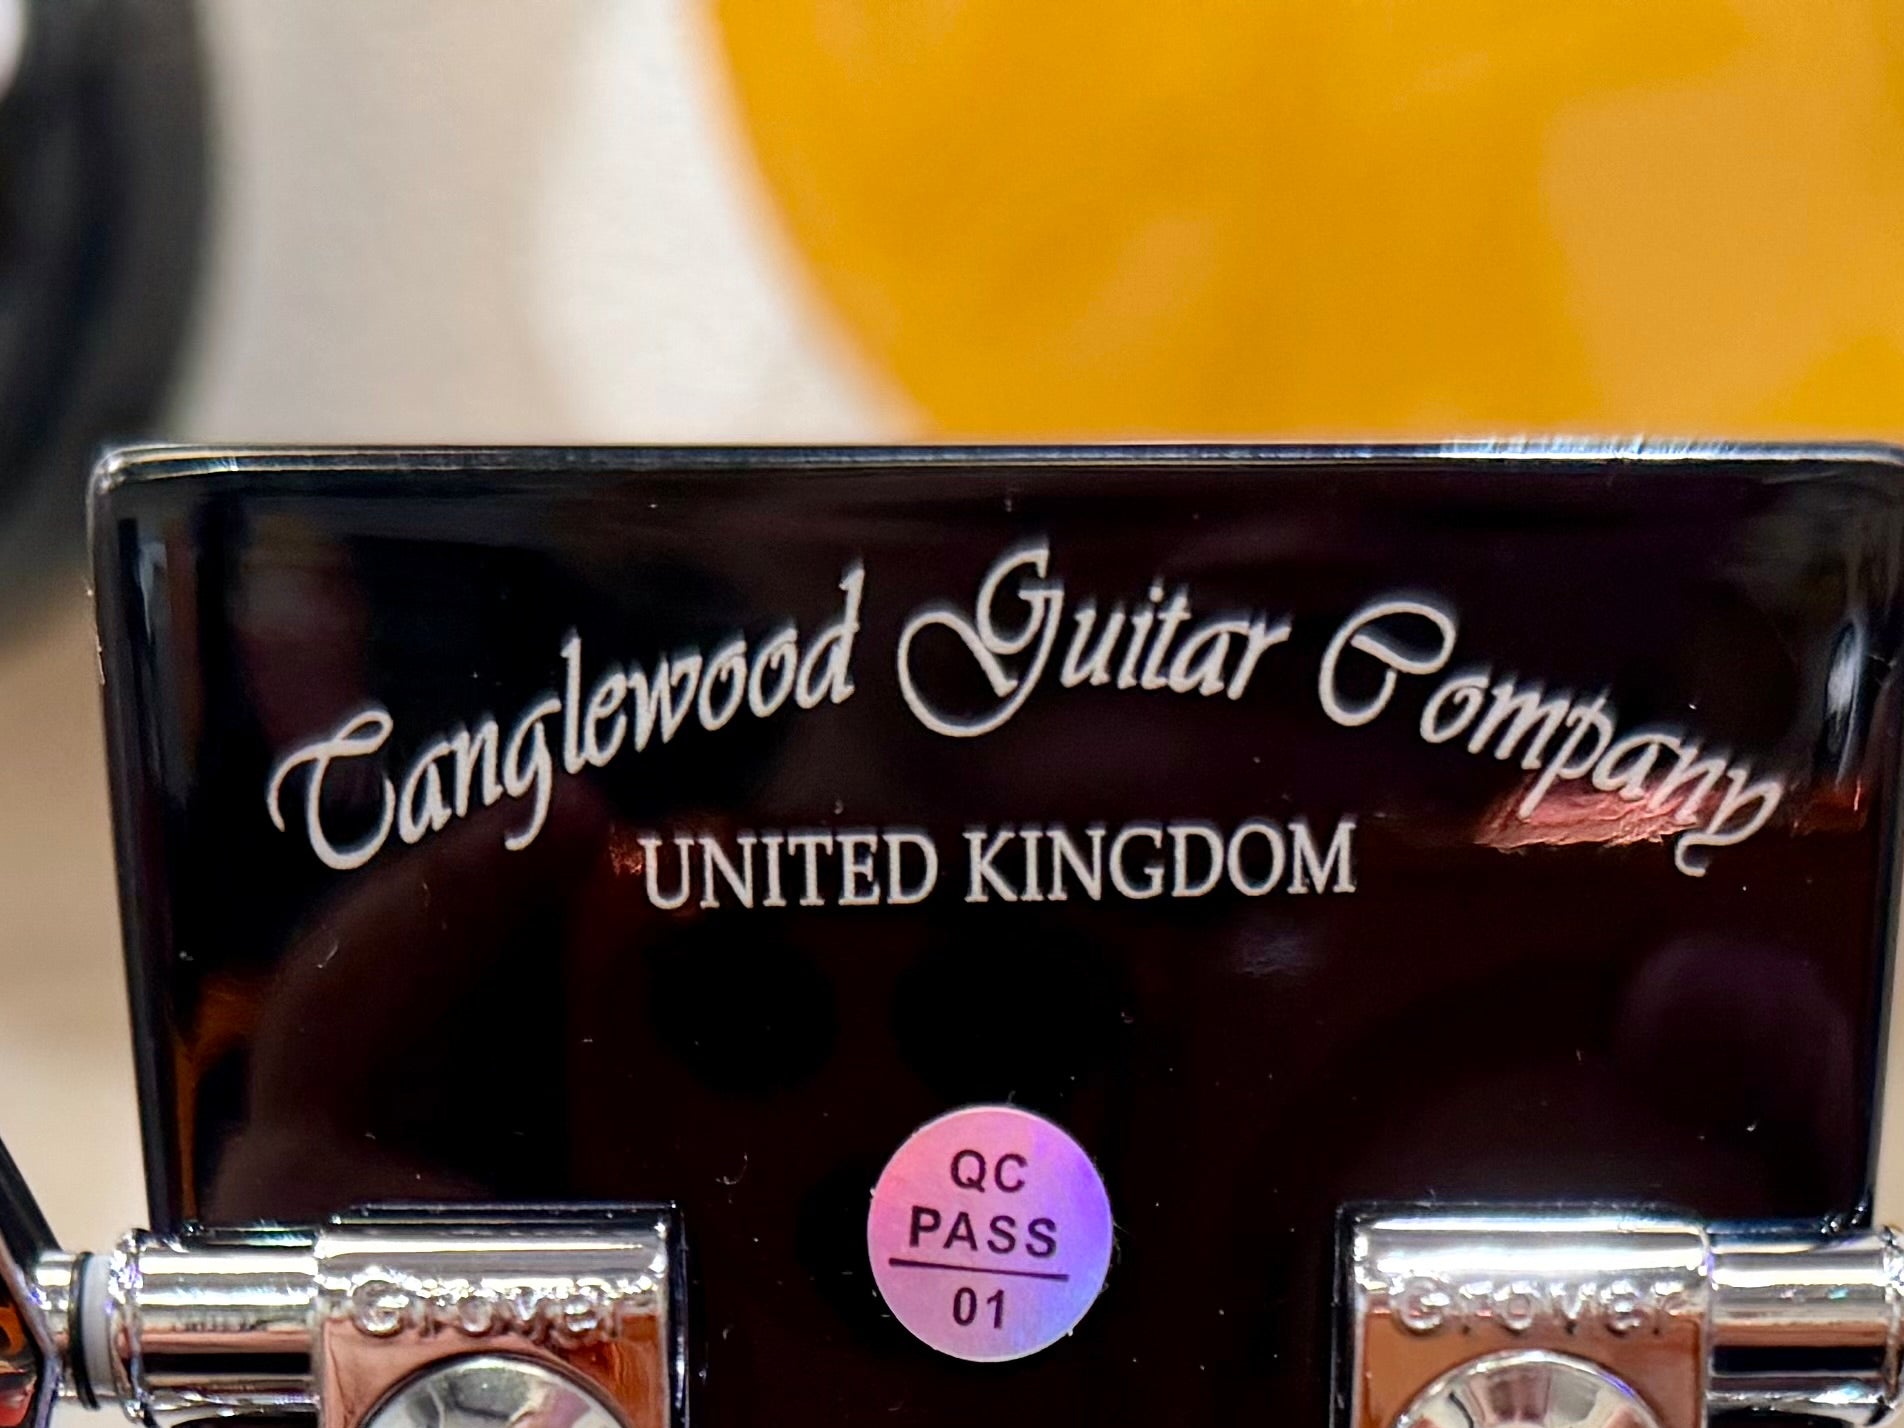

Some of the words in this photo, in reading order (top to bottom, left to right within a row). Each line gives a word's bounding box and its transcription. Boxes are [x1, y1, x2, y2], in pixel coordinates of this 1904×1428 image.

[266, 556, 866, 870] Tanglewood
[896, 540, 1291, 738] Guitar
[1318, 600, 1783, 877] Company
[636, 828, 939, 910] UNITED
[961, 820, 1358, 903] KINGDOM
[950, 1149, 1028, 1194] QC
[908, 1204, 1058, 1260] PASS
[351, 1268, 654, 1343] Grover
[952, 1286, 1005, 1330] 01
[1393, 1276, 1691, 1336] Grover
